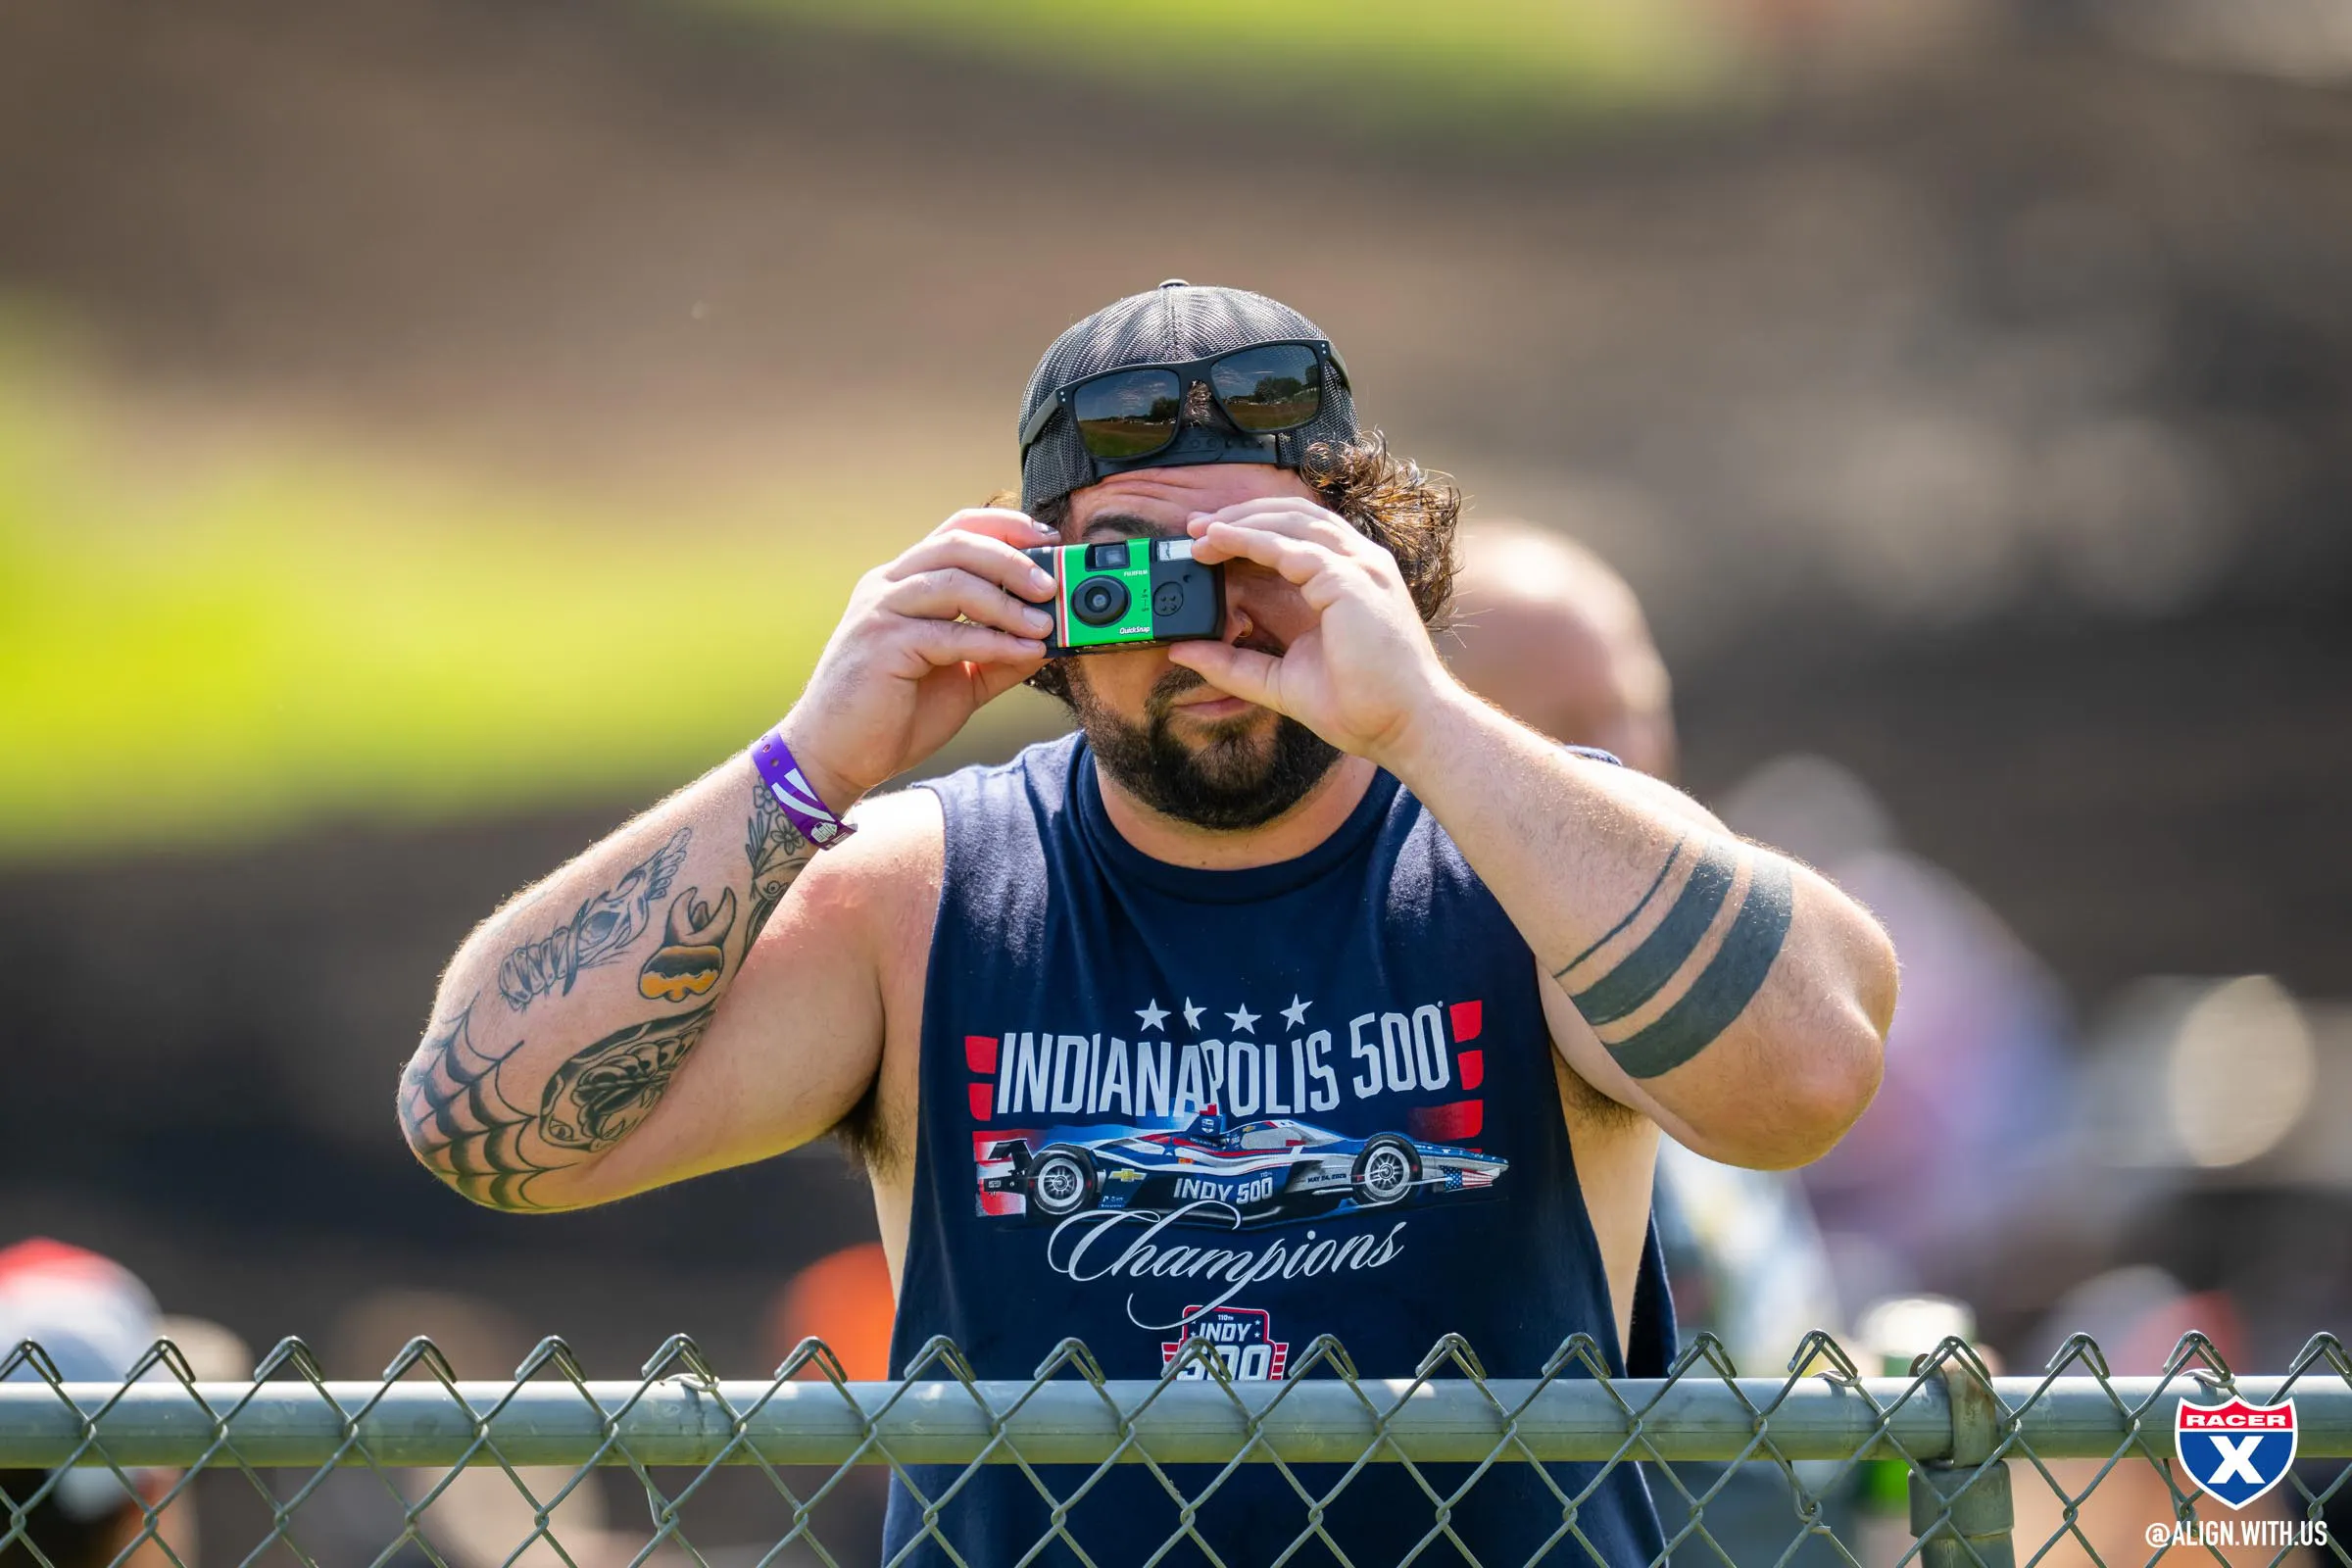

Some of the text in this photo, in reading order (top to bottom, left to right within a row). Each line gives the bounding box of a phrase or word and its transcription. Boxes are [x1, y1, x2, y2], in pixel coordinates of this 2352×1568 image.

[1119, 625, 1151, 635] QuickSnap
[997, 1004, 1450, 1118] INDIANAPOLIS 500
[1173, 1177, 1273, 1204] INDY 500
[1048, 1200, 1406, 1330] Champions
[1199, 1322, 1252, 1342] INDY
